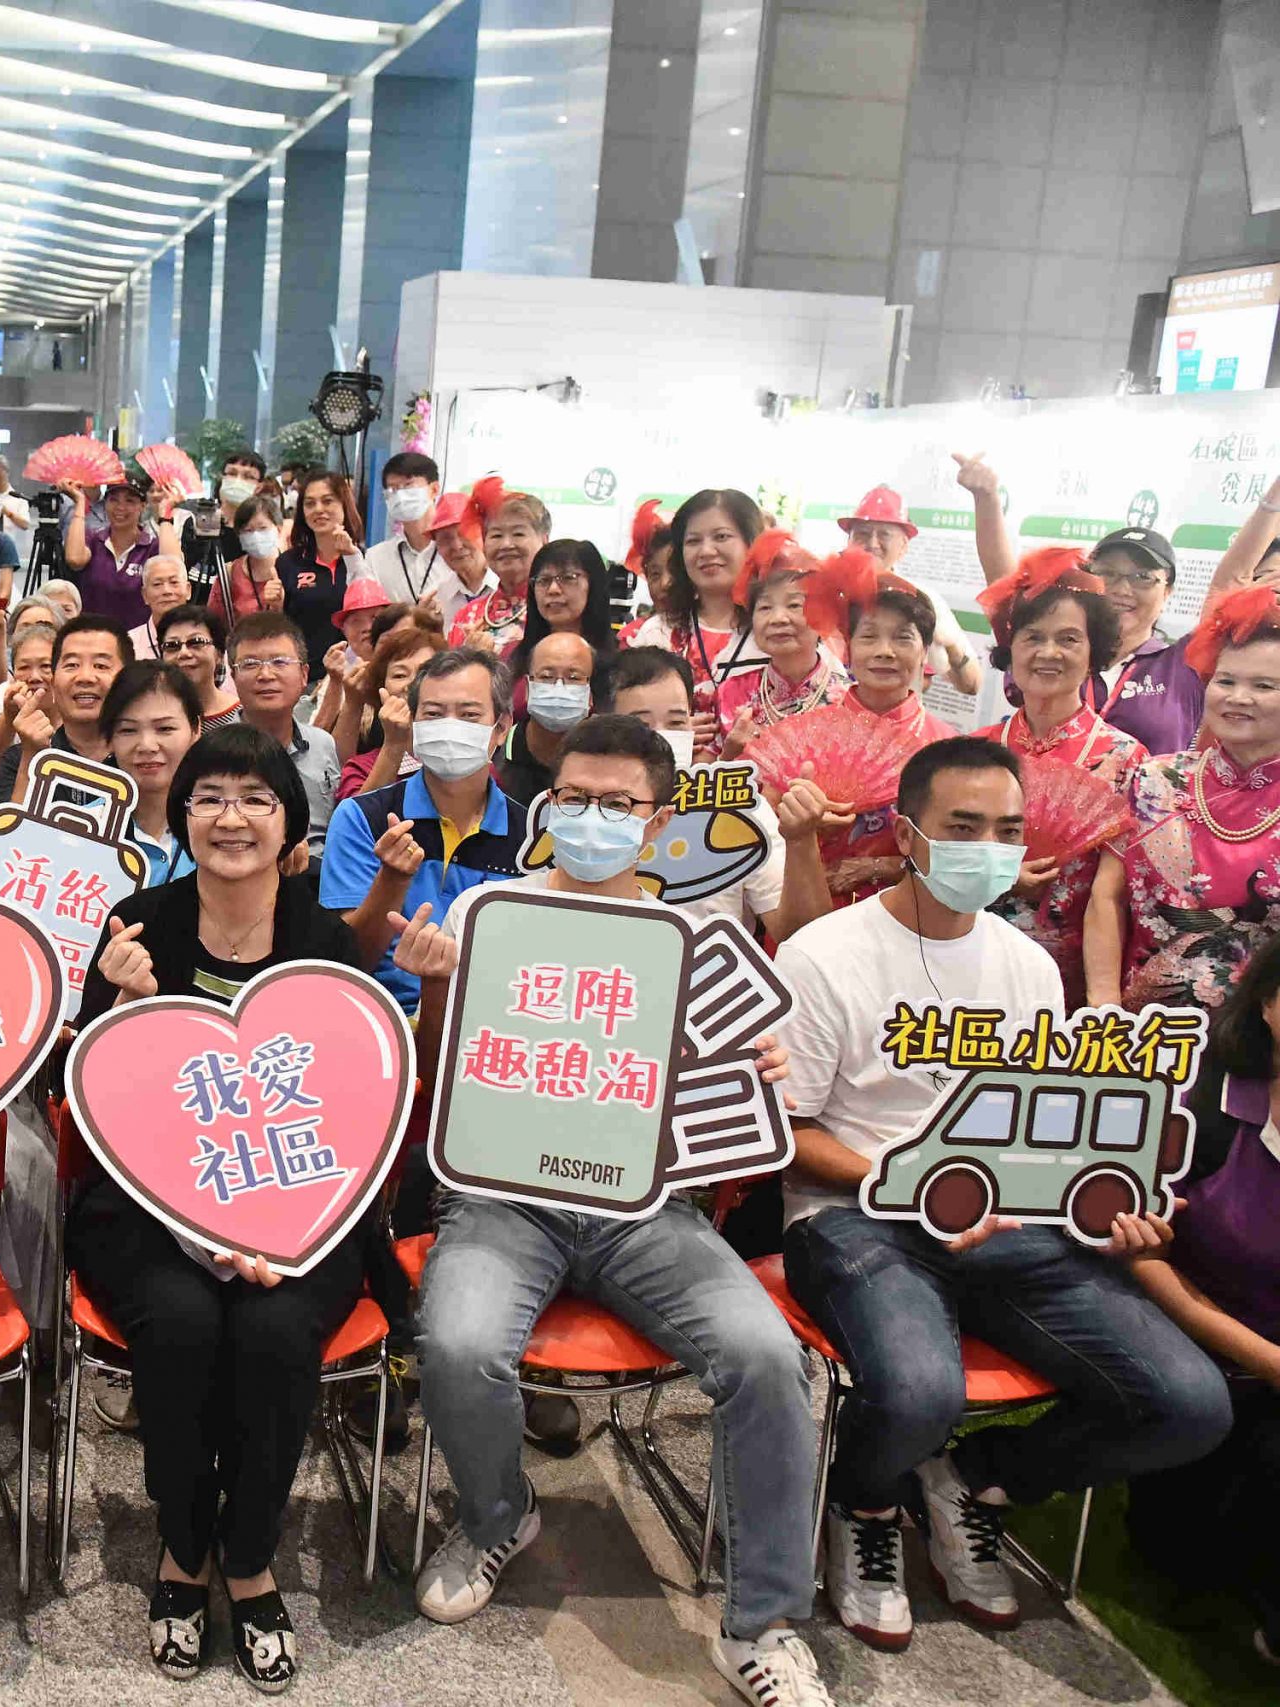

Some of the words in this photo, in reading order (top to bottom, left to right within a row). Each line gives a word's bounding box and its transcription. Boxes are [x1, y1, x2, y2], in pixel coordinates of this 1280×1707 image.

[670, 767, 759, 813] 社區
[507, 965, 634, 1036] 逗陣
[176, 1035, 322, 1123] 我愛
[463, 1029, 660, 1110] 趣憩淘
[884, 1006, 1203, 1083] 社區小旅行
[192, 1117, 347, 1201] 社區
[538, 1153, 625, 1188] PASSPORT
